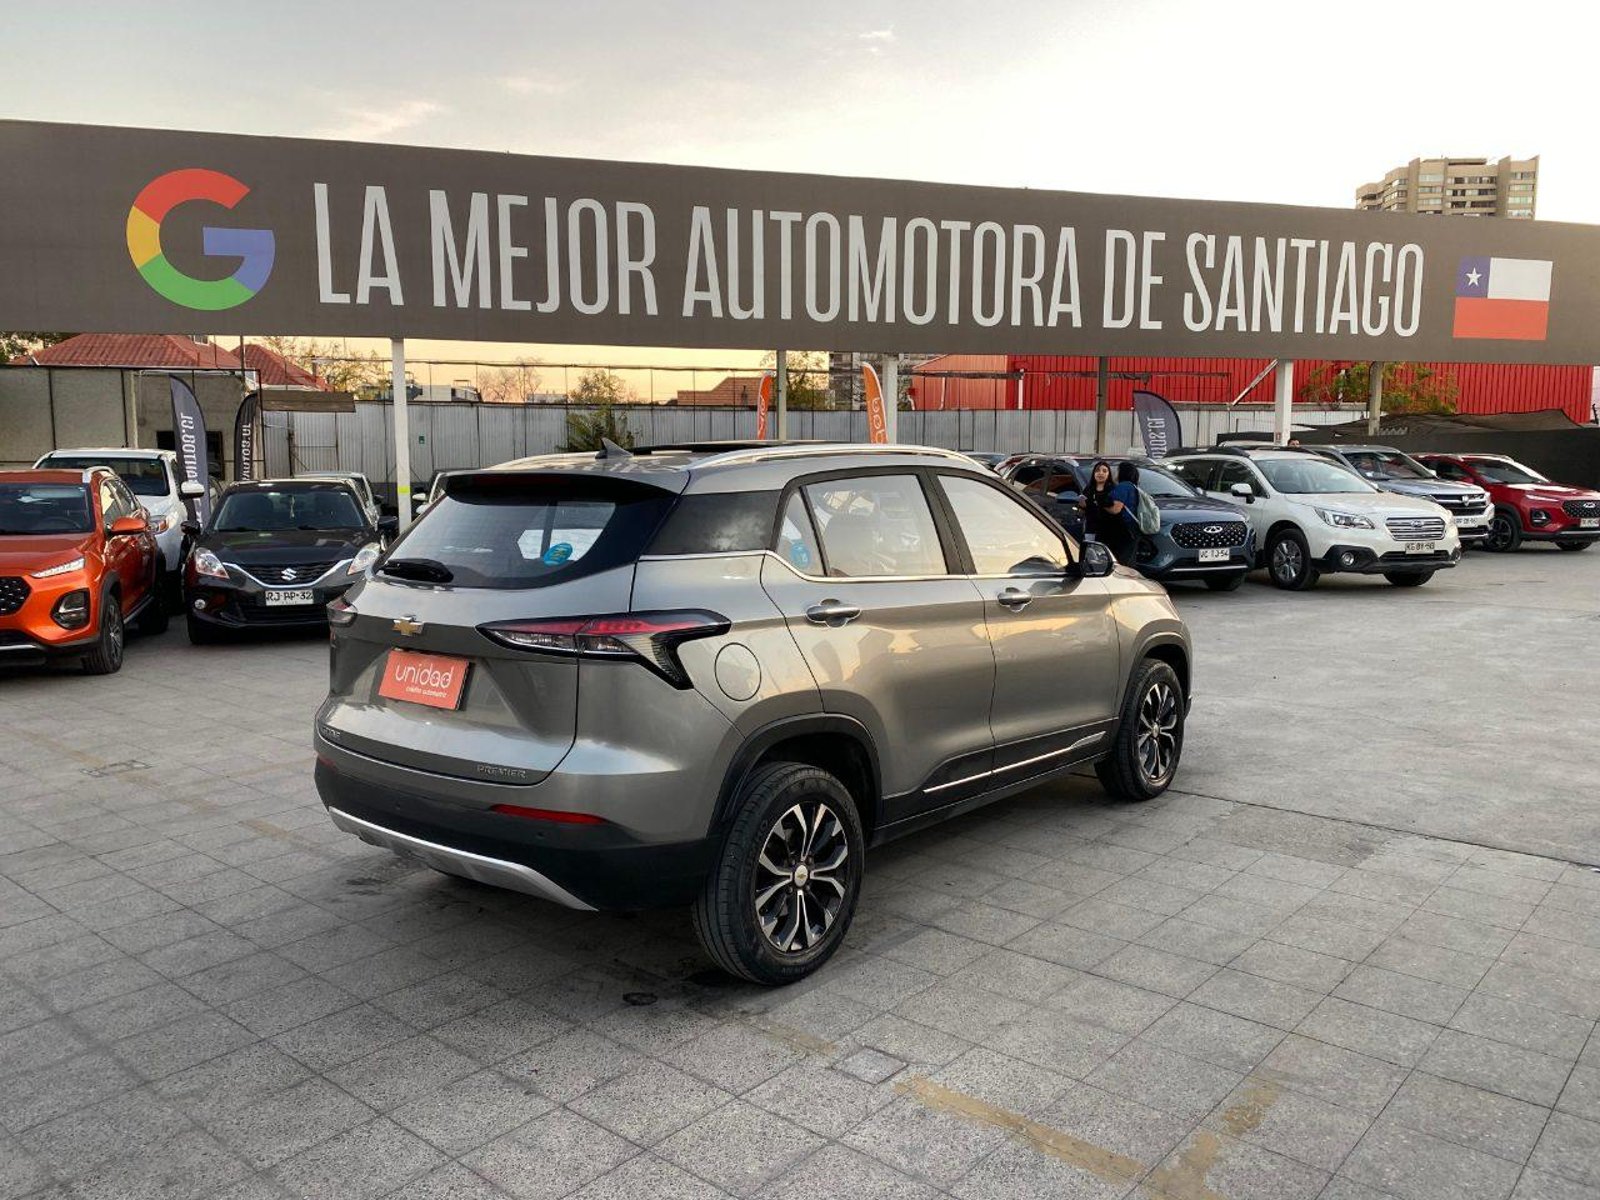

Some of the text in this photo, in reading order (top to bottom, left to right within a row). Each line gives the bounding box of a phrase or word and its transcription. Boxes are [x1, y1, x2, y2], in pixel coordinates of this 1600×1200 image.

[126, 168, 275, 310] G
[314, 183, 1424, 336] LA MEJOR AUTOMOTORA DE SANTIAGO
[395, 662, 454, 689] unidad
